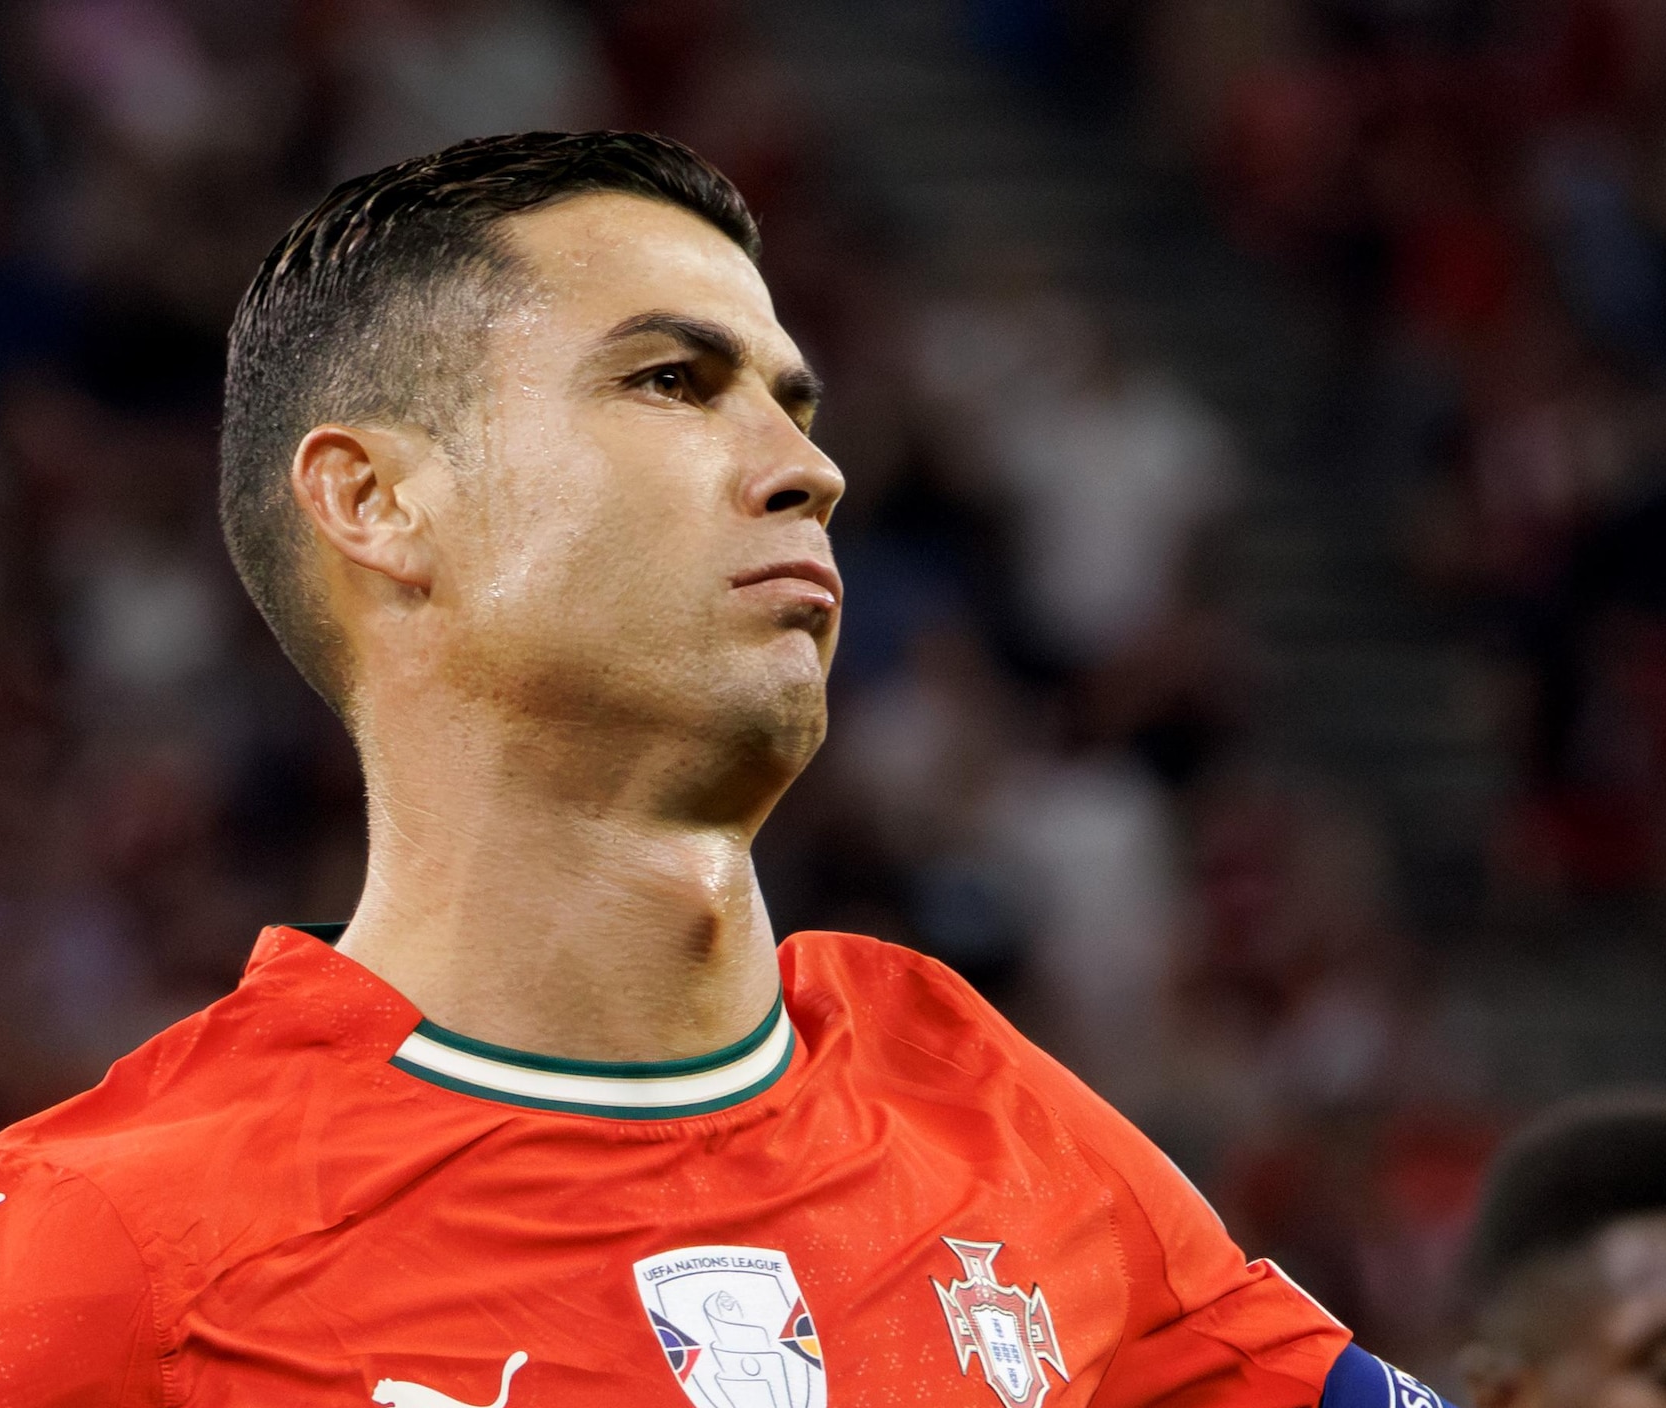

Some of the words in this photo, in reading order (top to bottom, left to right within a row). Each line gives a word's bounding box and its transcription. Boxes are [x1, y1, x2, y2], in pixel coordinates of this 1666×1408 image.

[643, 1264, 674, 1281] UEFA
[674, 1257, 729, 1272] NATIONS
[731, 1257, 782, 1272] LEAGUE
